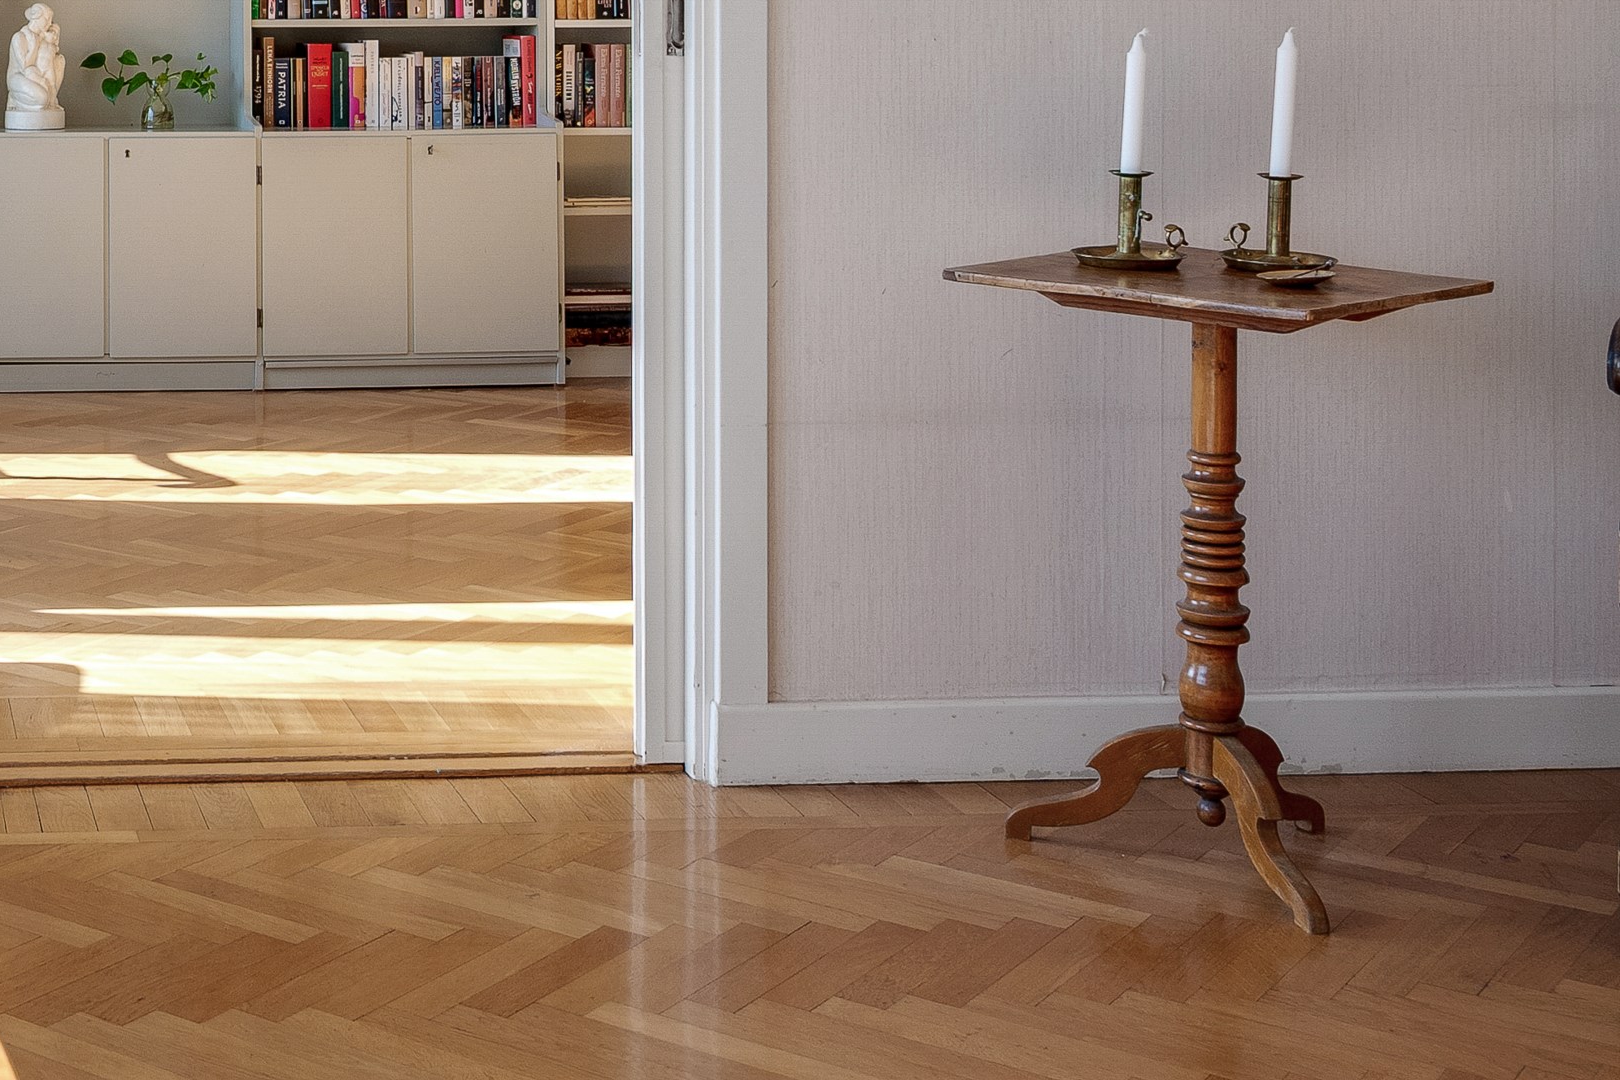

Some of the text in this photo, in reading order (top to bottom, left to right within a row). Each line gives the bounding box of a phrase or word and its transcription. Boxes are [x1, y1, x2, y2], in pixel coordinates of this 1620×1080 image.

[555, 50, 563, 97] NEW YORK
[253, 85, 262, 104] 1794
[277, 71, 287, 109] PATRIA
[434, 81, 442, 106] WESTÖ
